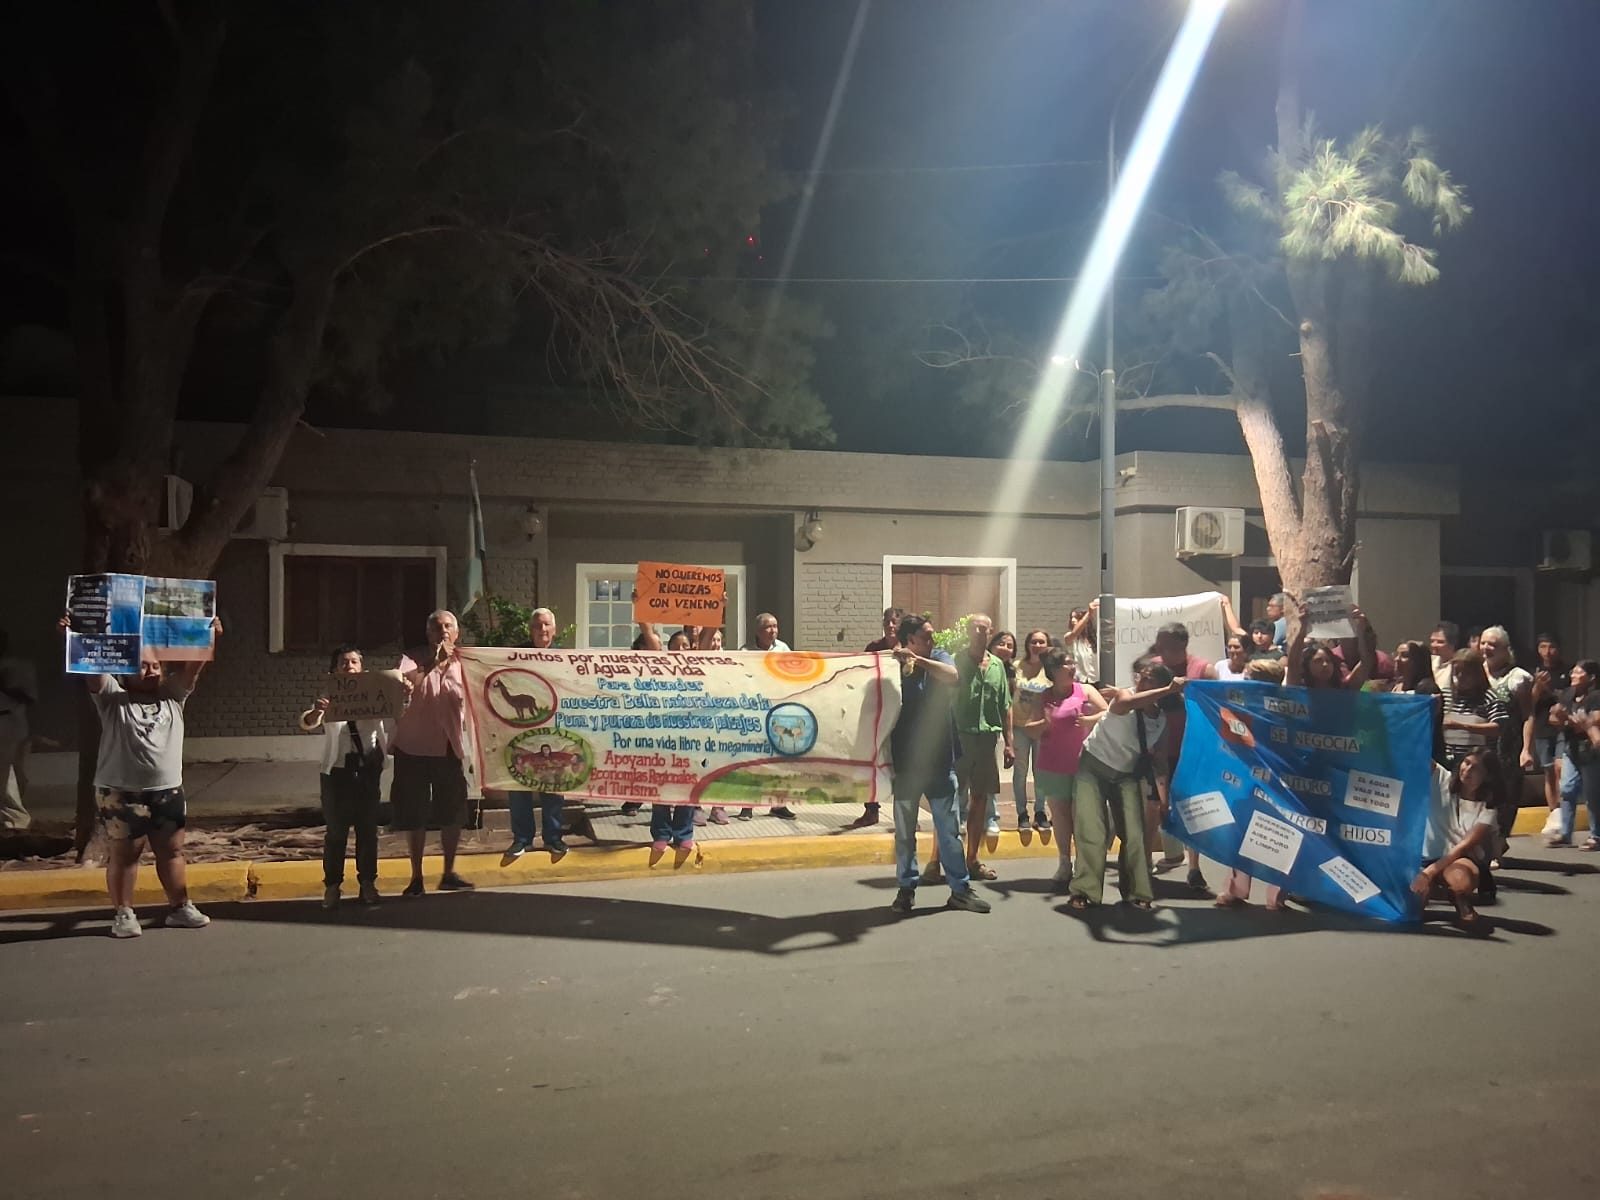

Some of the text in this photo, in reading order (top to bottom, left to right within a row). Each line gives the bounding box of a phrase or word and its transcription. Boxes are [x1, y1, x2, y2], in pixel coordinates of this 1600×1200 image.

[656, 569, 722, 582] NO QUEREMOS
[658, 582, 711, 595] RIQUEZAS
[649, 598, 719, 610] CON VENENO
[1187, 619, 1219, 638] OCIAL
[506, 652, 563, 662] Juntos
[568, 654, 594, 665] por
[600, 653, 671, 665] nuestras
[576, 663, 589, 676] el
[594, 664, 631, 678] Agua
[633, 666, 643, 676] y
[645, 664, 664, 676] la
[337, 677, 358, 691] NO
[597, 678, 704, 692] Para defender
[560, 692, 772, 711] nuestra Bella naturaleza de la
[1268, 699, 1308, 716] AGUA
[590, 714, 598, 731] y
[601, 714, 646, 732] pureza
[646, 712, 662, 728] de
[663, 712, 714, 728] nuestros
[714, 713, 762, 736] paisajes
[613, 732, 630, 748] Por
[635, 737, 654, 748] una
[656, 735, 676, 750] vida
[680, 736, 701, 752] libre
[704, 736, 716, 752] de
[1230, 720, 1247, 734] NO
[1296, 732, 1359, 752] NEGOCIA
[604, 750, 690, 770] Apoyando las
[588, 784, 596, 797] y
[598, 781, 608, 796] el
[1344, 826, 1390, 844] HIJOS.
